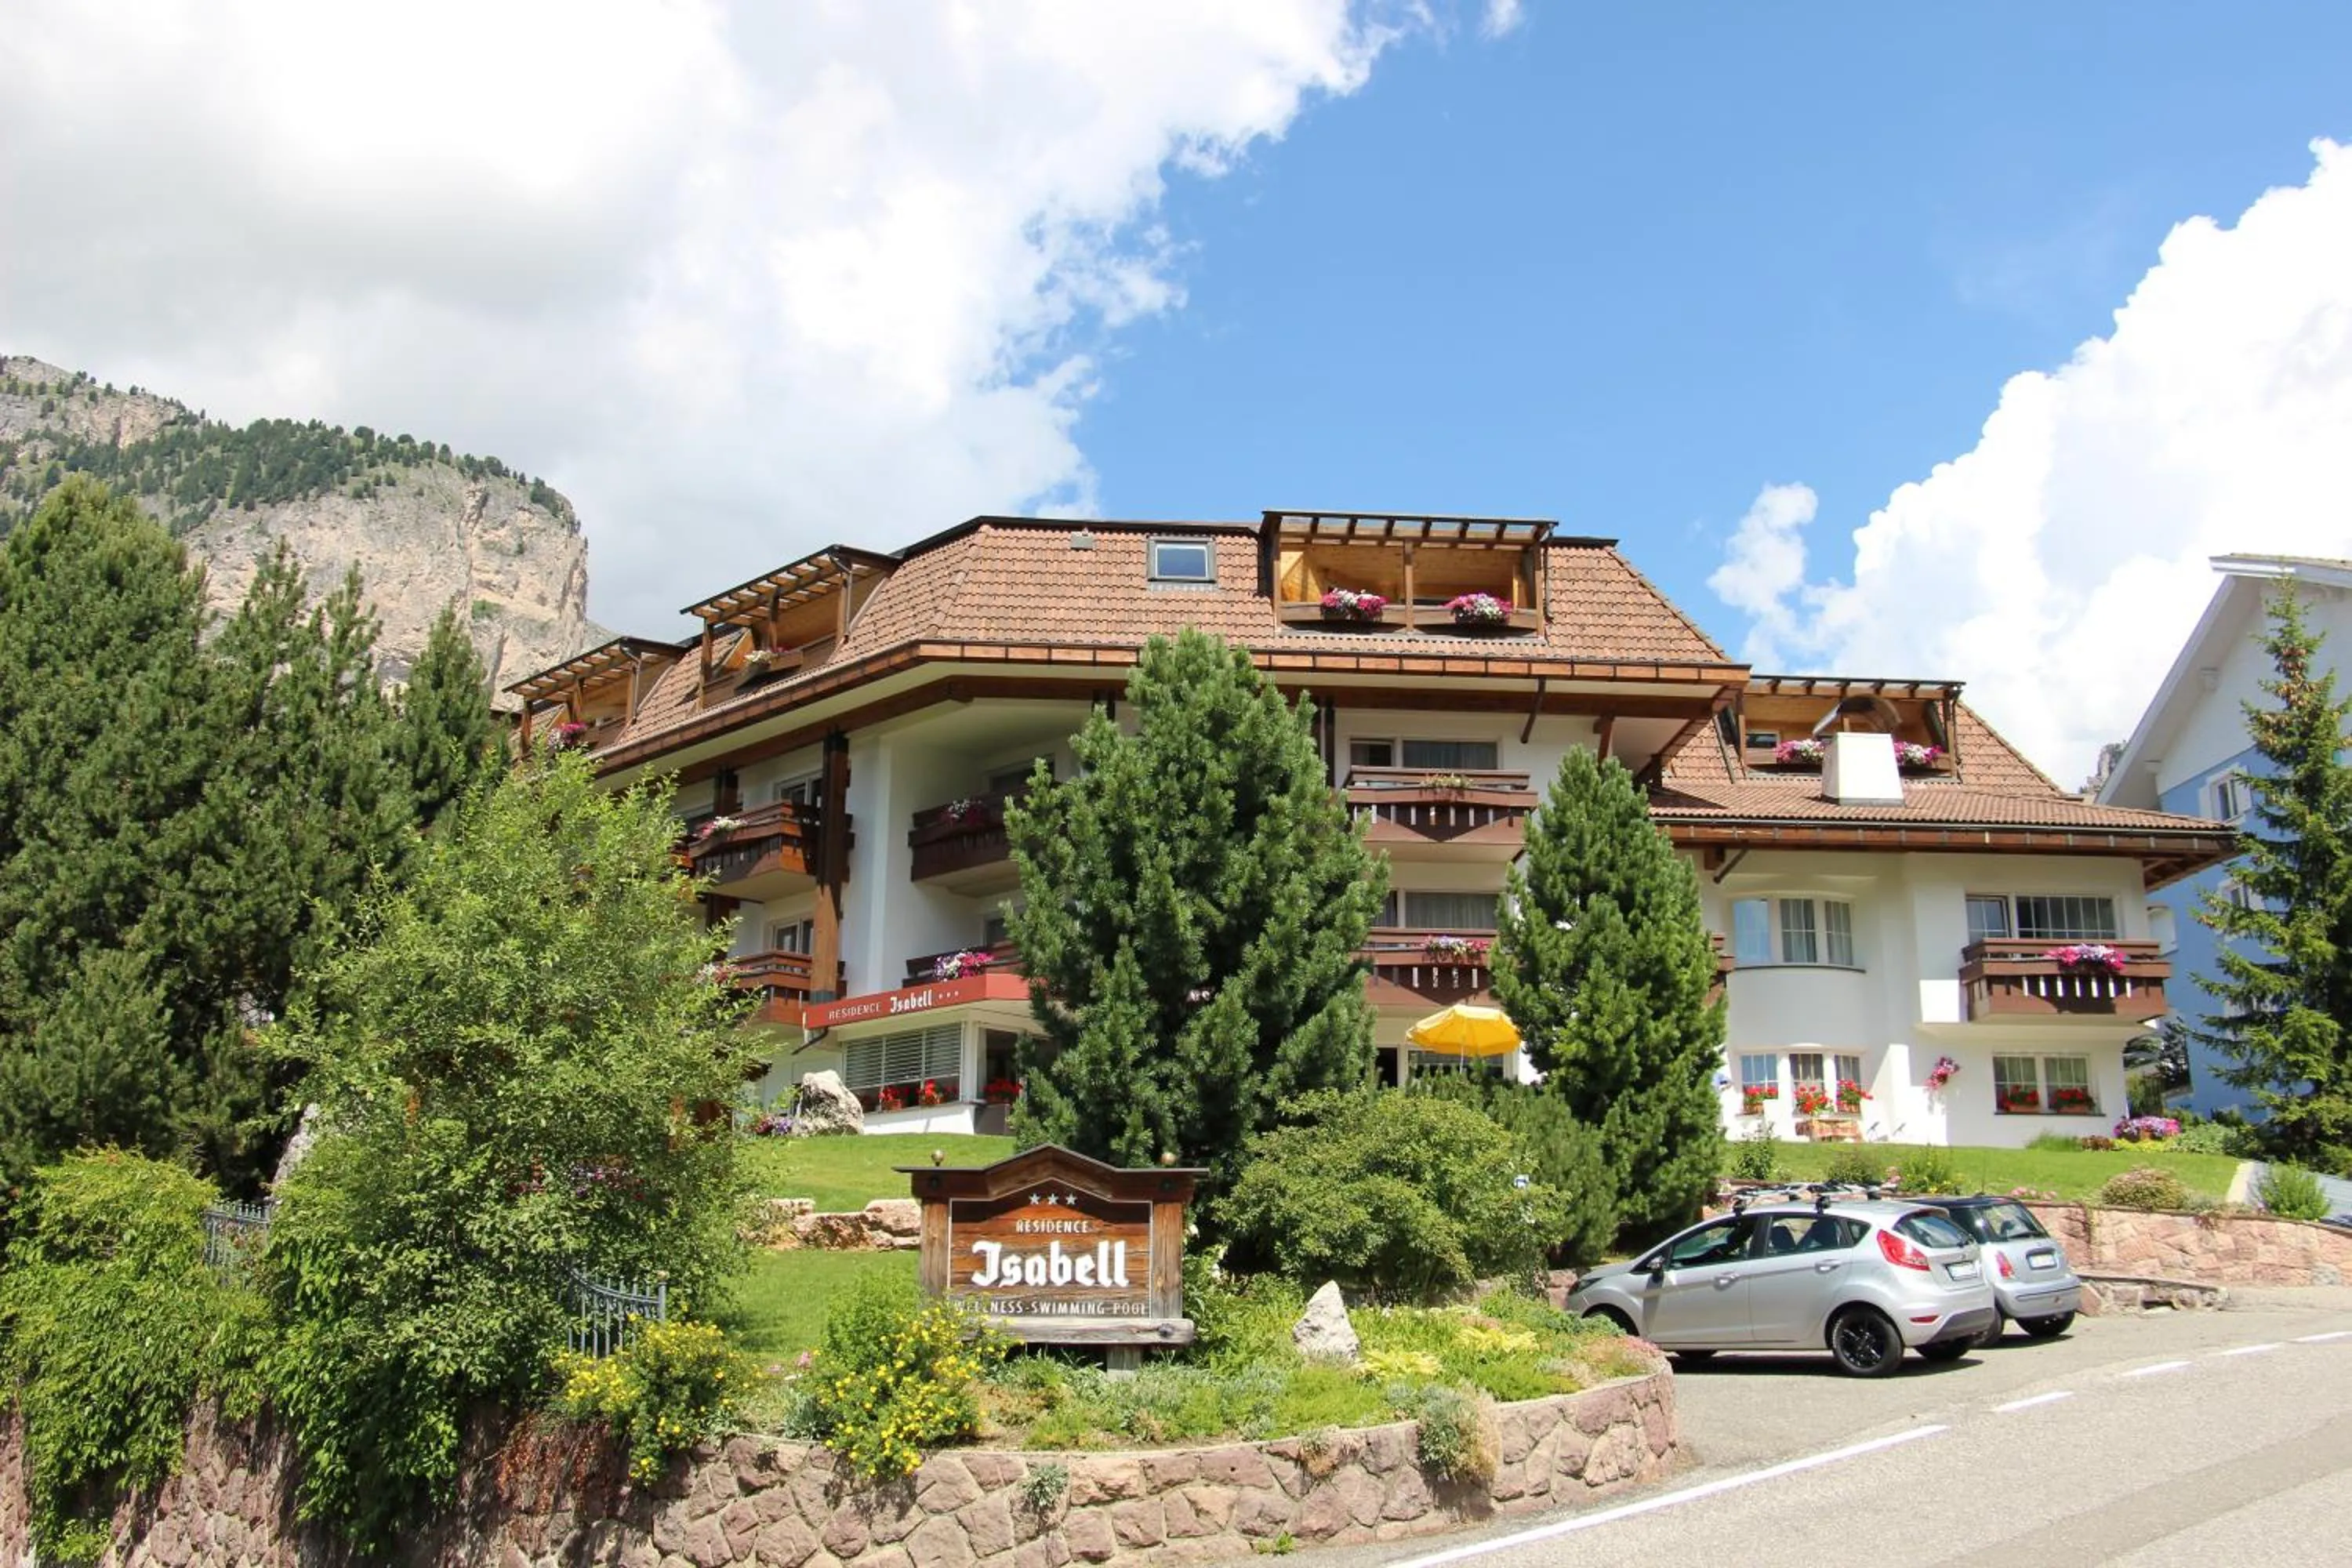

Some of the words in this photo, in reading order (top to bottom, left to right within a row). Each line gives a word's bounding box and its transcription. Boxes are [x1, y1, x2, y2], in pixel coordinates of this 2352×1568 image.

[828, 1002, 881, 1020] RESIDENCE
[890, 989, 932, 1013] Isabell
[1015, 1219, 1089, 1233] RESIDENCE
[971, 1240, 1129, 1288] Isabell
[1113, 1302, 1147, 1315] POOL
